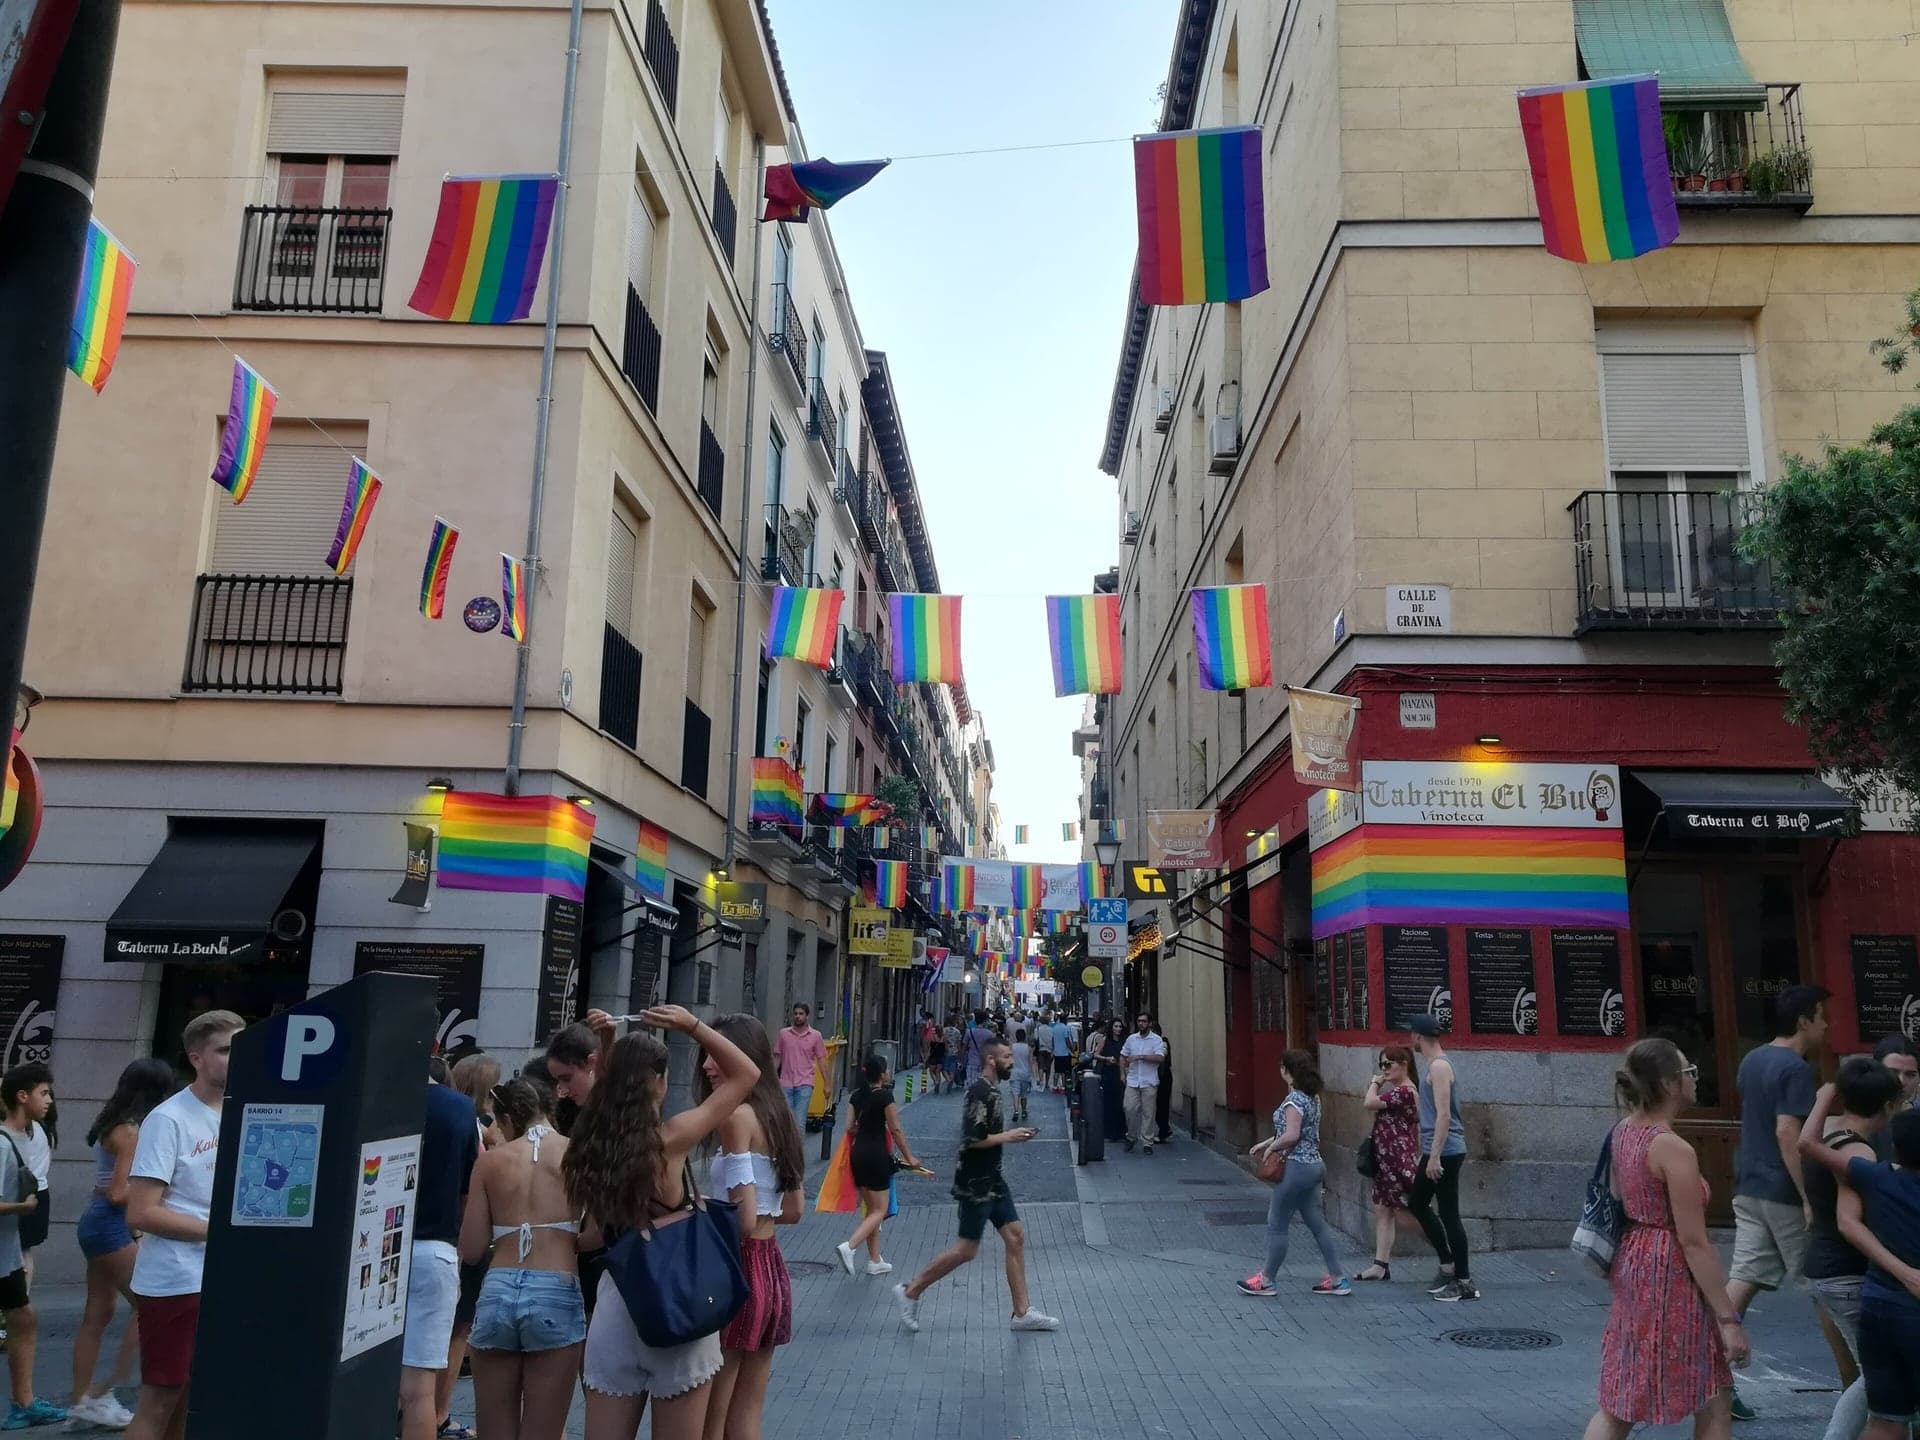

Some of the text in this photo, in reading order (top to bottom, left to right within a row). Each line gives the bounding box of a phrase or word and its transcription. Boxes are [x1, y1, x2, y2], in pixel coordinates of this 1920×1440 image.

[1398, 589, 1436, 601] CALLE
[1411, 603, 1425, 613] DE
[1428, 776, 1482, 787] desde 1970
[1367, 779, 1484, 809] Taberna
[1491, 783, 1528, 810] El
[1421, 810, 1484, 822] Vinoteca
[1687, 814, 1744, 828] Taberna
[1751, 815, 1770, 828] El
[117, 941, 169, 953] Taberna
[172, 943, 190, 955] La
[281, 1014, 336, 1082] P
[247, 1107, 273, 1115] BARRIO
